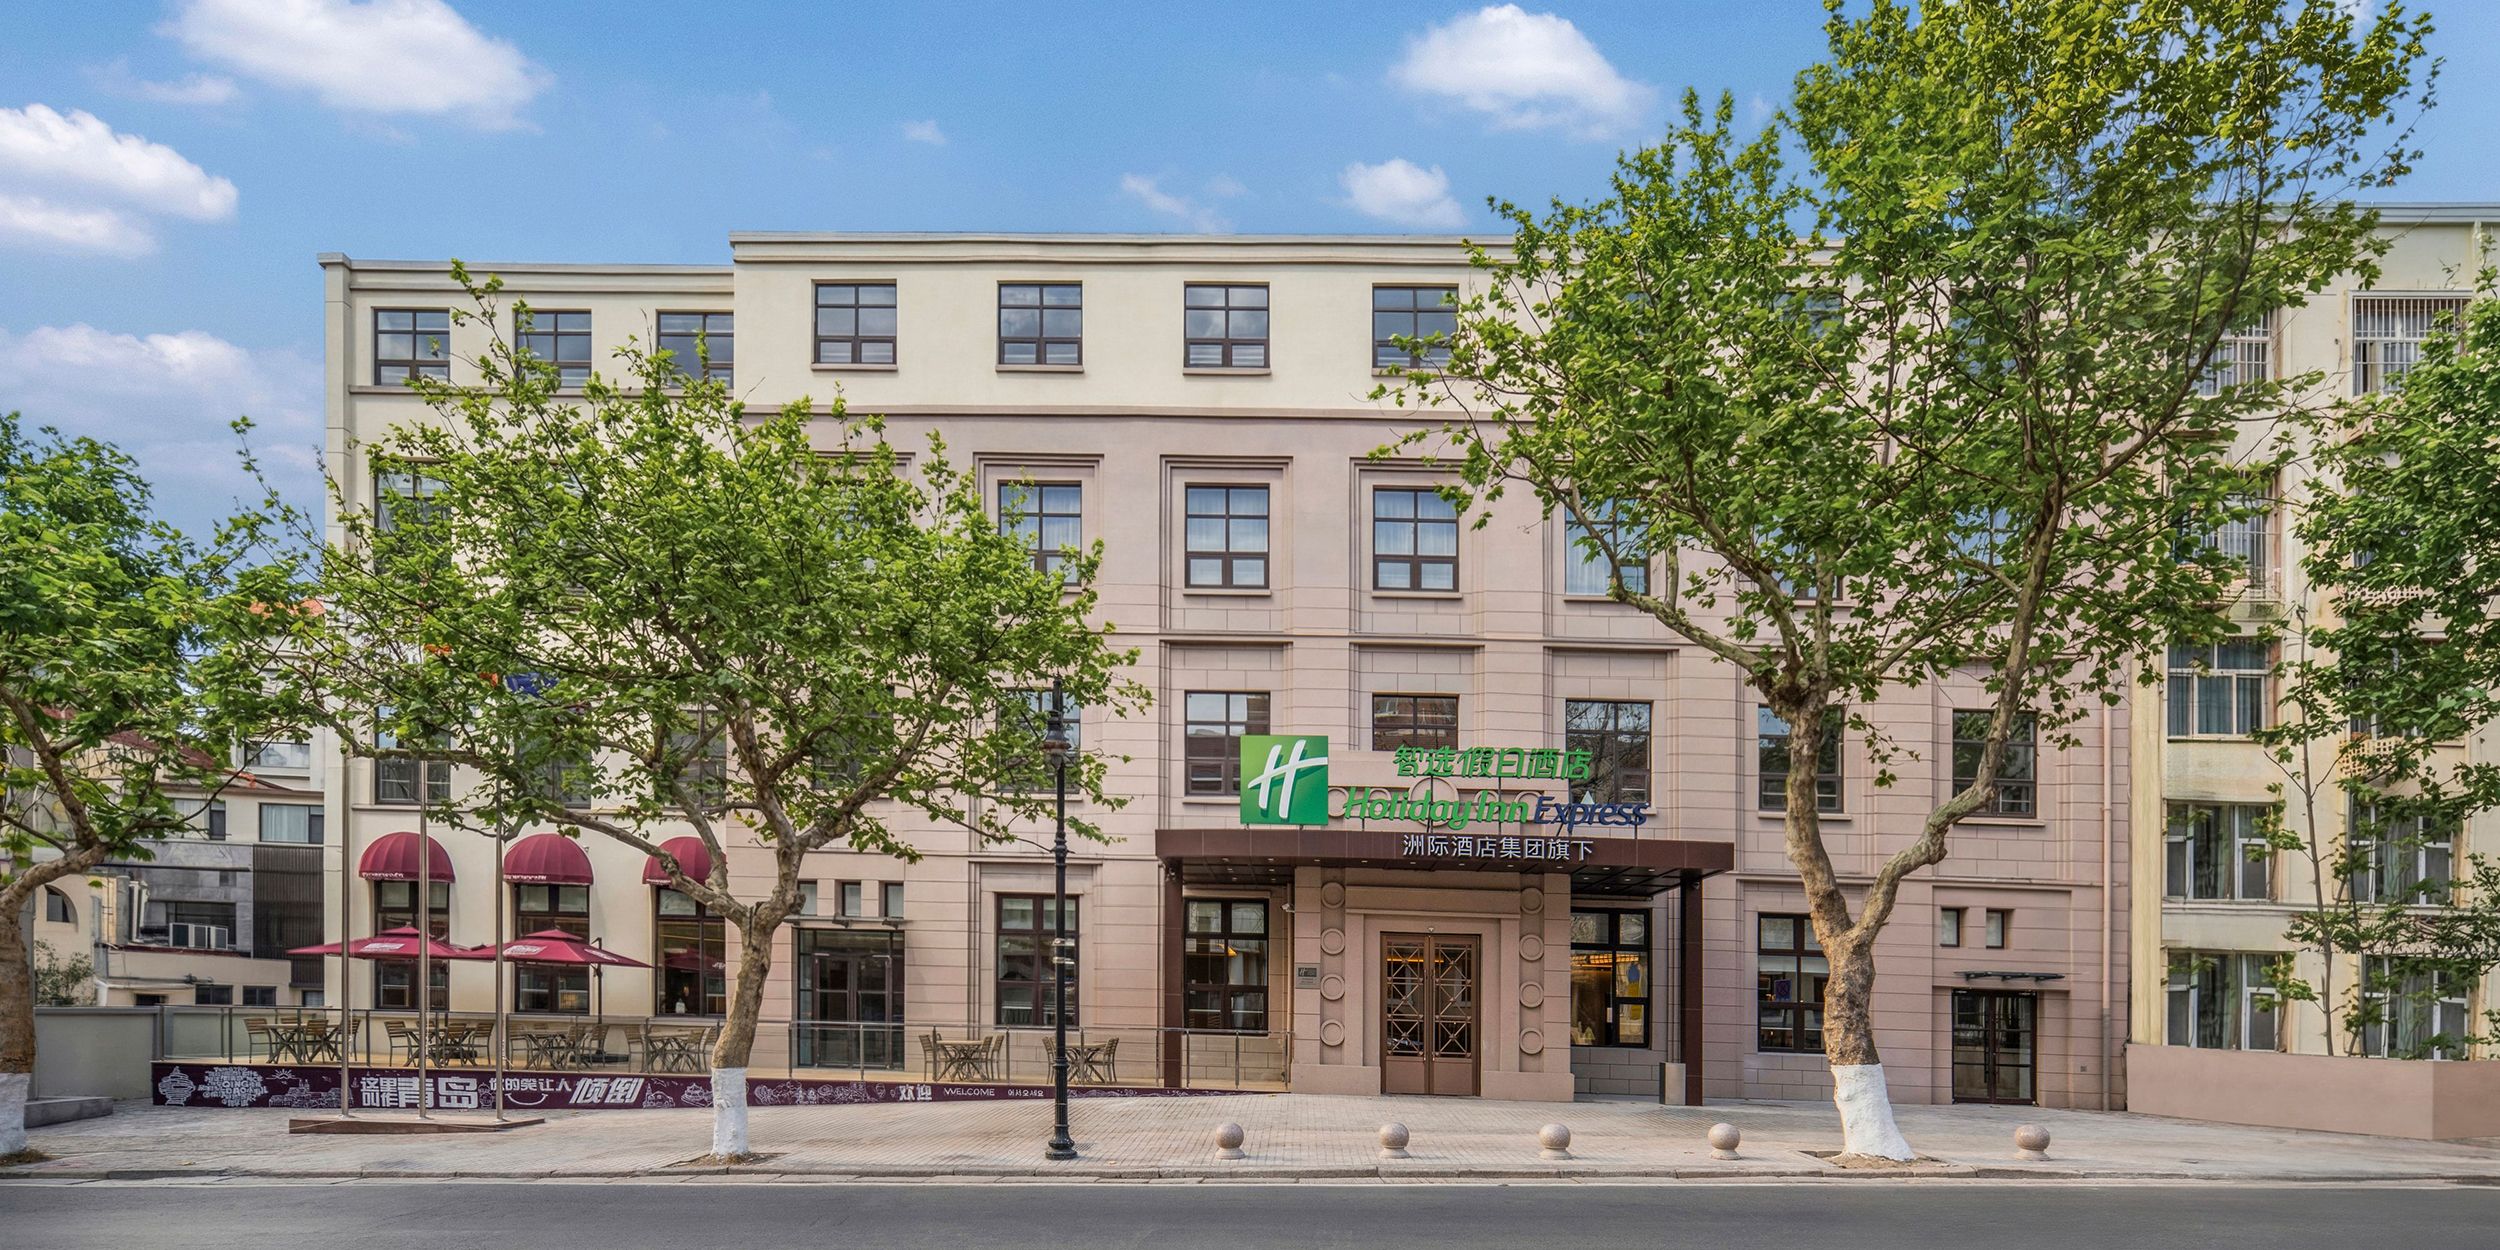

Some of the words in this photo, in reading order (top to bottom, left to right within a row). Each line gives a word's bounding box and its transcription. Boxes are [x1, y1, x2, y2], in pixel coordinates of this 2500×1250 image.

[1393, 744, 1593, 780] 智选假日酒店
[1343, 786, 1470, 830] Holiday
[1476, 790, 1529, 823] Inn
[1533, 796, 1650, 834] Express
[1403, 834, 1594, 861] 洲际酒店集团旗下
[360, 1077, 398, 1092] 这里
[398, 1076, 479, 1108] 青岛
[898, 1084, 933, 1102] 欢迎
[944, 1087, 995, 1097] WELCOME
[1007, 1088, 1045, 1098] 어서오세요
[362, 1092, 398, 1107] 叫作
